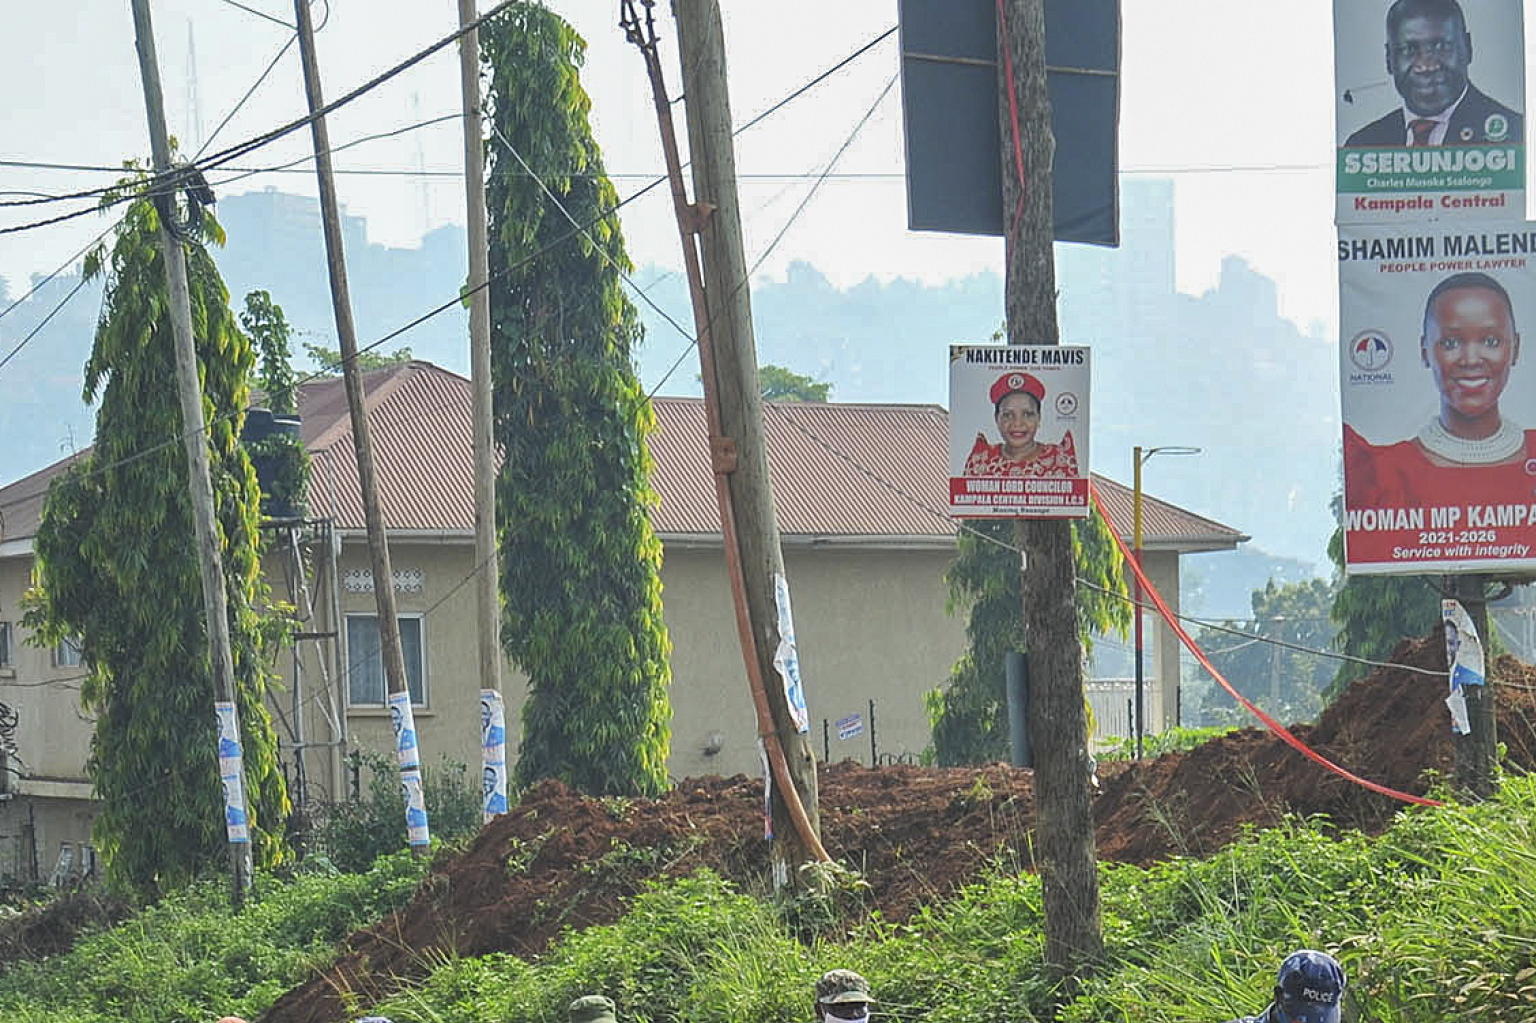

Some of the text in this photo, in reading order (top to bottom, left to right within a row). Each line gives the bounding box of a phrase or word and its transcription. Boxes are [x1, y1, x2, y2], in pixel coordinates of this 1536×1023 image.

[1345, 149, 1516, 174] SSERUNJOGI
[1367, 177, 1404, 188] Charles
[1354, 192, 1506, 213] Kampala Central
[1338, 235, 1434, 261] SHAMIM
[1379, 258, 1527, 273] PEOPLE POWER LAWYER
[966, 349, 1084, 365] NAKITENDE MAVIS
[966, 480, 1000, 493] WOMAN
[1002, 480, 1024, 493] LORD
[954, 494, 992, 505] KAMPALA
[993, 494, 1027, 505] CENTRAL
[1345, 508, 1424, 532] WOMAN
[1431, 507, 1462, 530] MP
[1419, 530, 1497, 544] 2021-2026
[1392, 543, 1530, 559] Service with integrity
[1303, 987, 1335, 1003] POLICE
